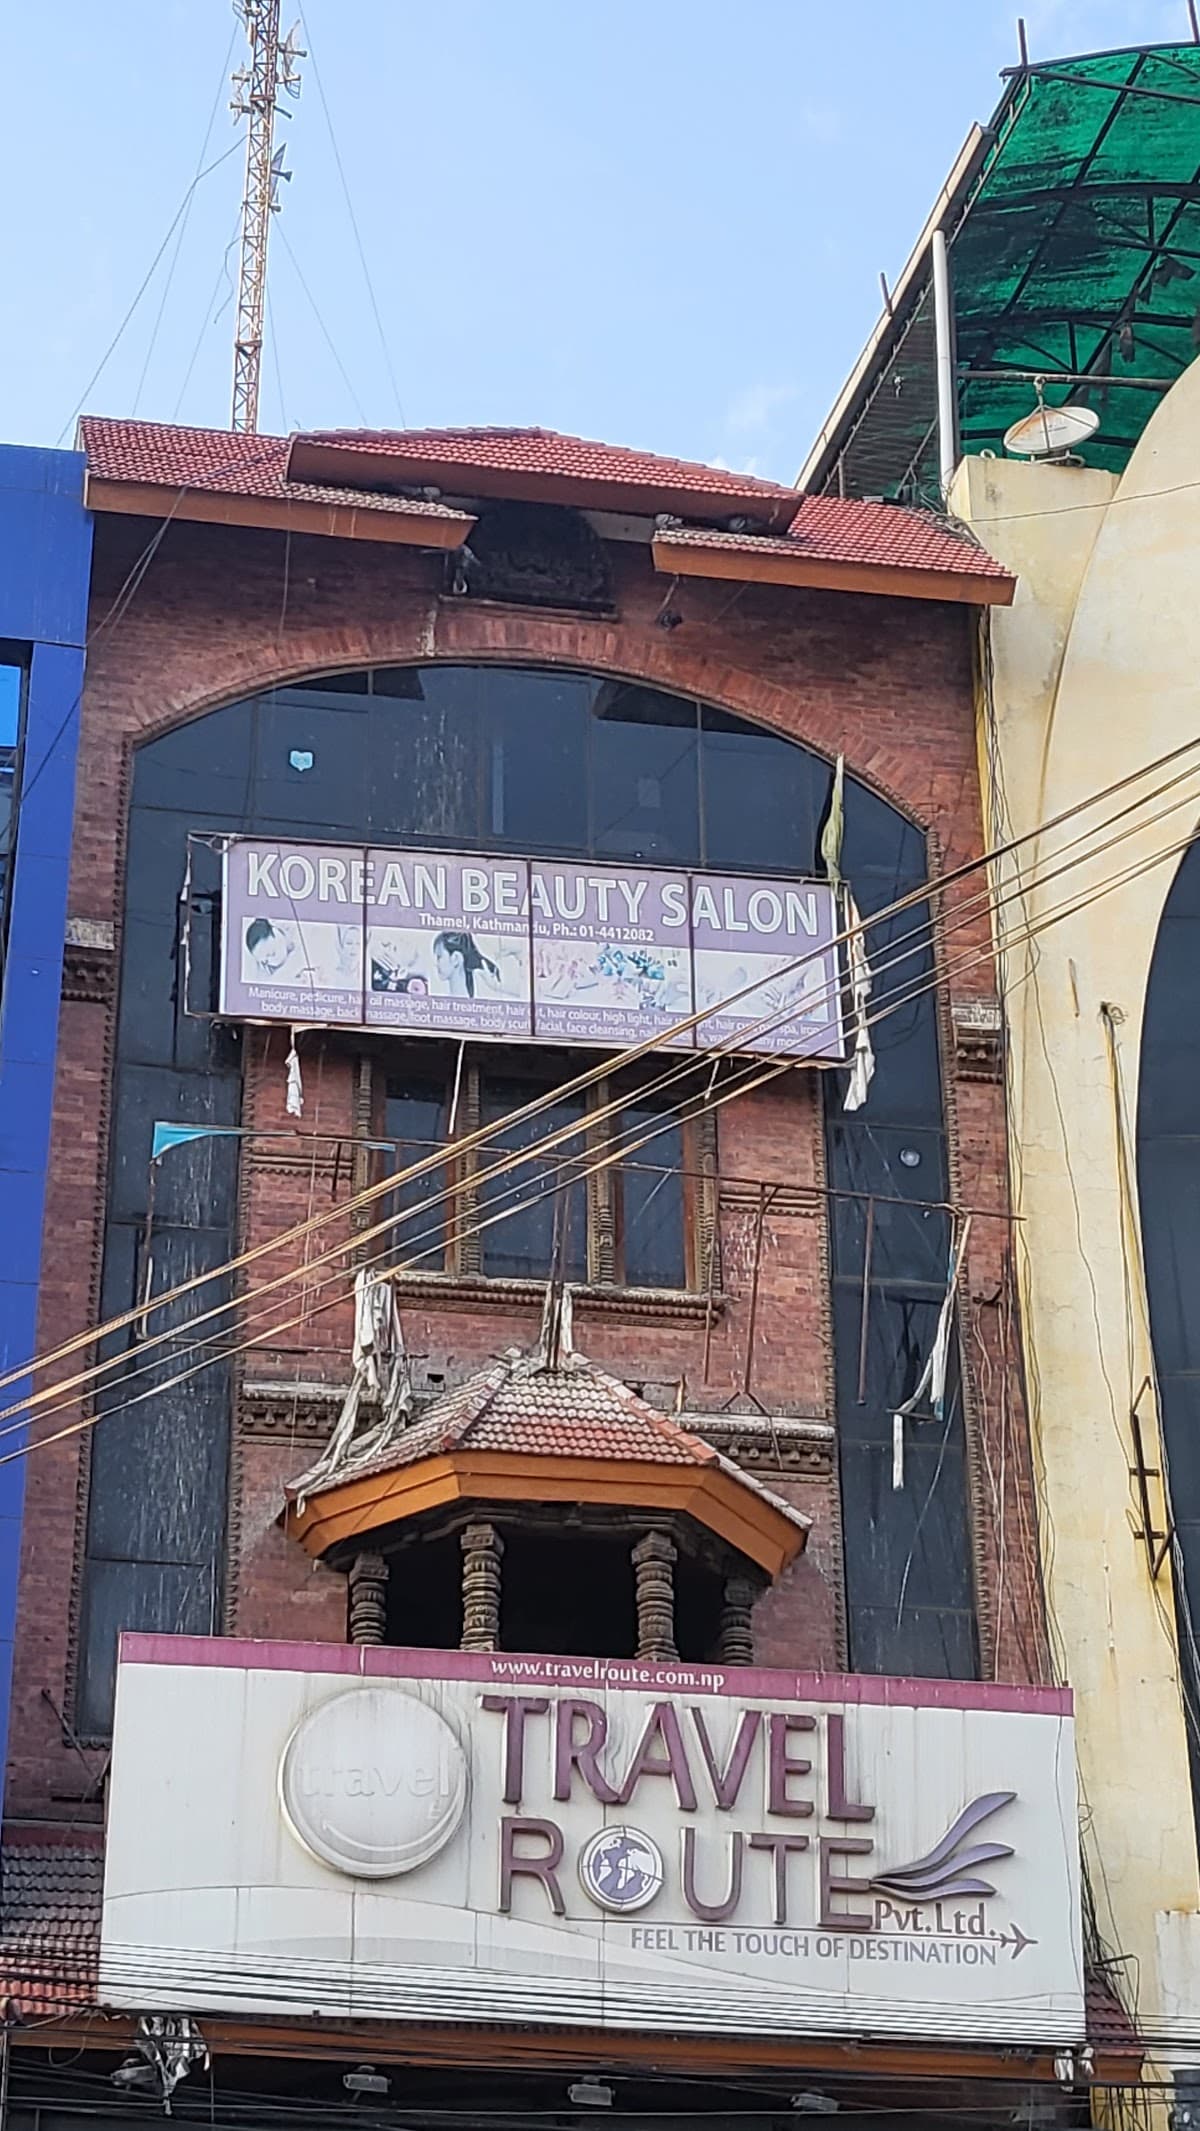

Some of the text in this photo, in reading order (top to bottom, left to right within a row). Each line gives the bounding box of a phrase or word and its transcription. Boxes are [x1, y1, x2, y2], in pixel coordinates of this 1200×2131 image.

[247, 851, 819, 937] KOREAN BEAUTY SALON
[419, 912, 471, 930] Thamel,
[248, 986, 299, 1001] Manicure,
[431, 998, 450, 1011] hair
[506, 1004, 525, 1017] hair
[547, 1007, 566, 1018] hair
[602, 1009, 626, 1025] high
[261, 1001, 288, 1016] body
[566, 1021, 587, 1035] face
[491, 1659, 725, 1693] www.travelroute.com.np
[478, 1693, 877, 1823] TRAVEL
[630, 1927, 998, 1967] FEEL THE TOUCH OF DESTINATION
